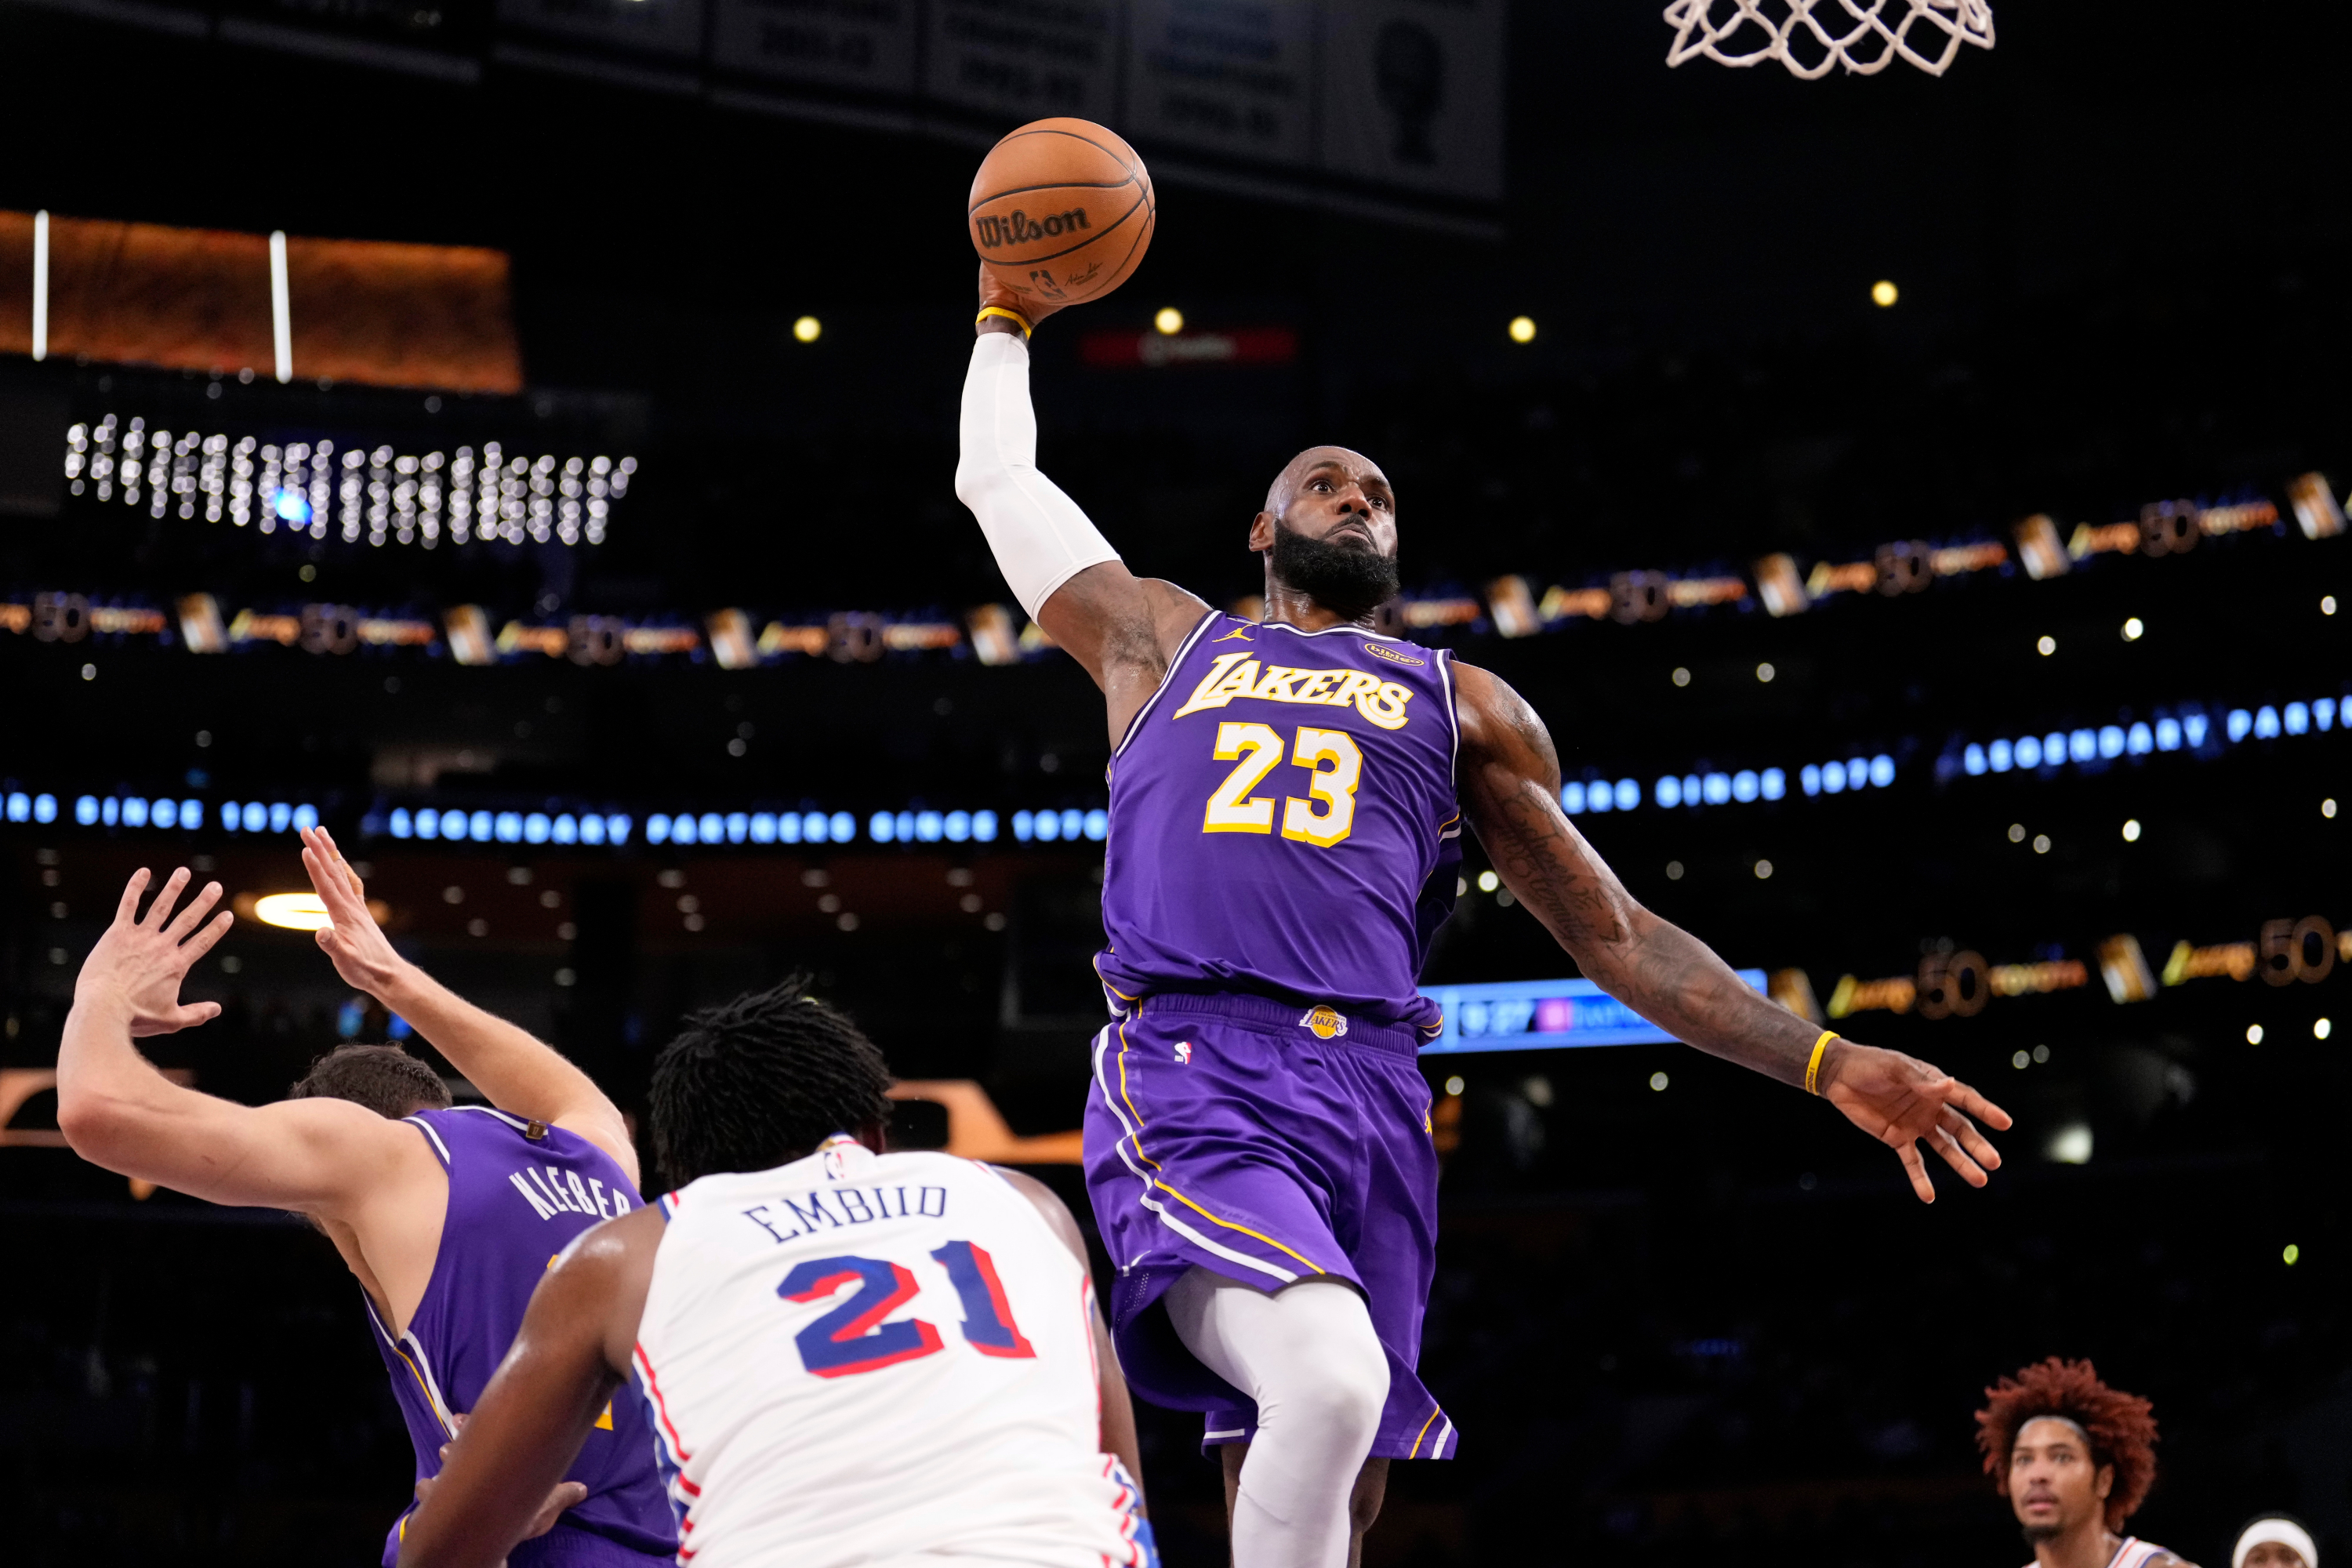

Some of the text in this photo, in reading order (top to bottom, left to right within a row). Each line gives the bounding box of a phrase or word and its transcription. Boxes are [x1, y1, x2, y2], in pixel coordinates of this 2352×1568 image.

[975, 207, 1091, 249] Wilson
[1173, 652, 1414, 730] LAKERS
[1202, 721, 1363, 848] 23
[1305, 1011, 1346, 1034] LAKERS
[509, 1167, 630, 1221] KLEBER
[741, 1186, 946, 1244] EMBIID
[776, 1240, 1037, 1379] 21
